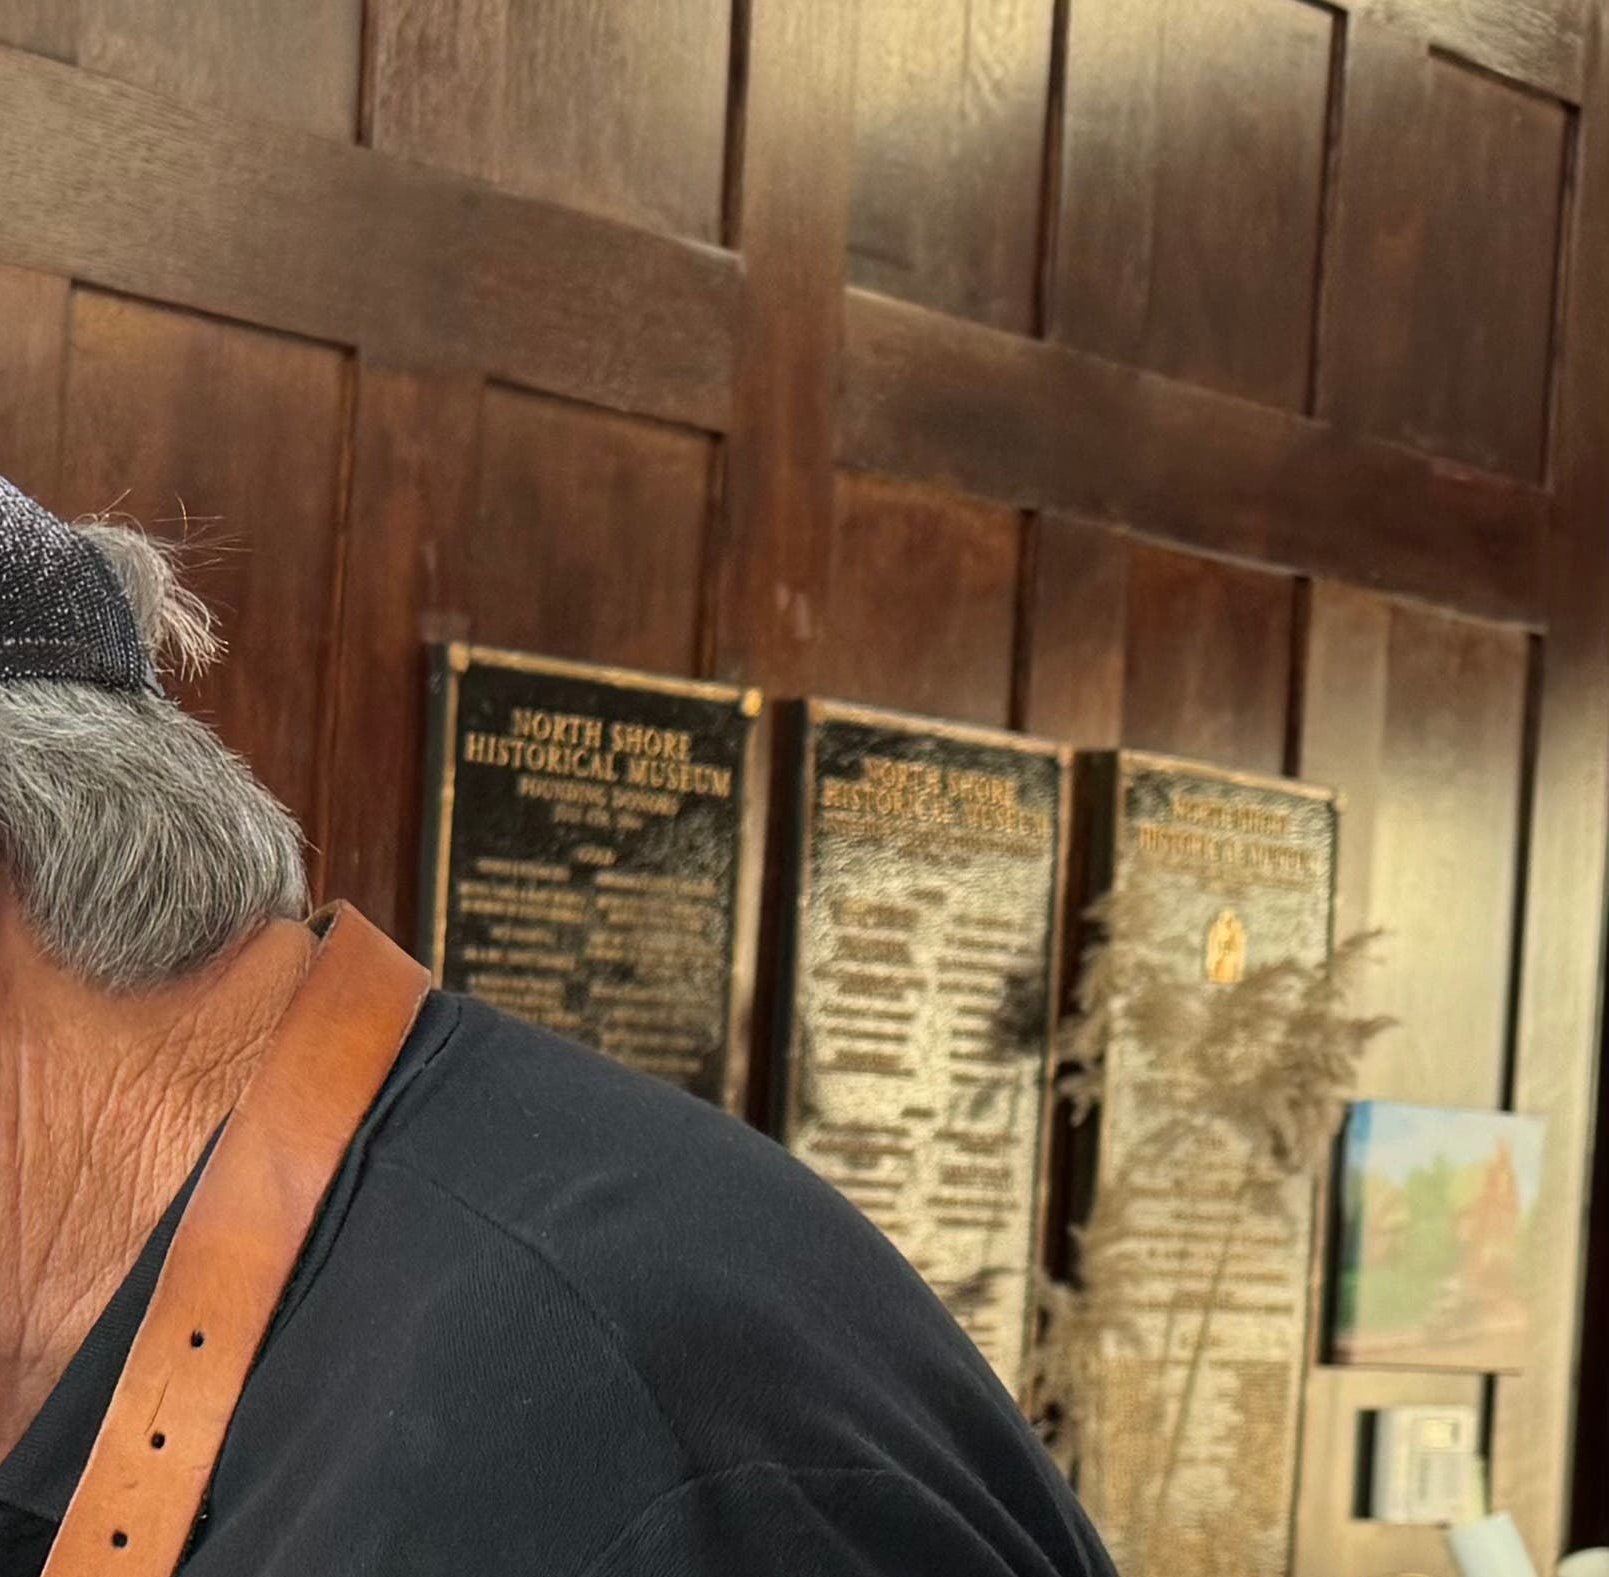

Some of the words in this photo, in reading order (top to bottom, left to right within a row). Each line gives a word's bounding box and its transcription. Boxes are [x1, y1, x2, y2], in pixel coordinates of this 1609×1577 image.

[464, 731, 619, 783] HISTORICAL
[628, 756, 733, 798] MUSEUM
[512, 708, 604, 748] NORTH
[610, 721, 693, 761] SHORE
